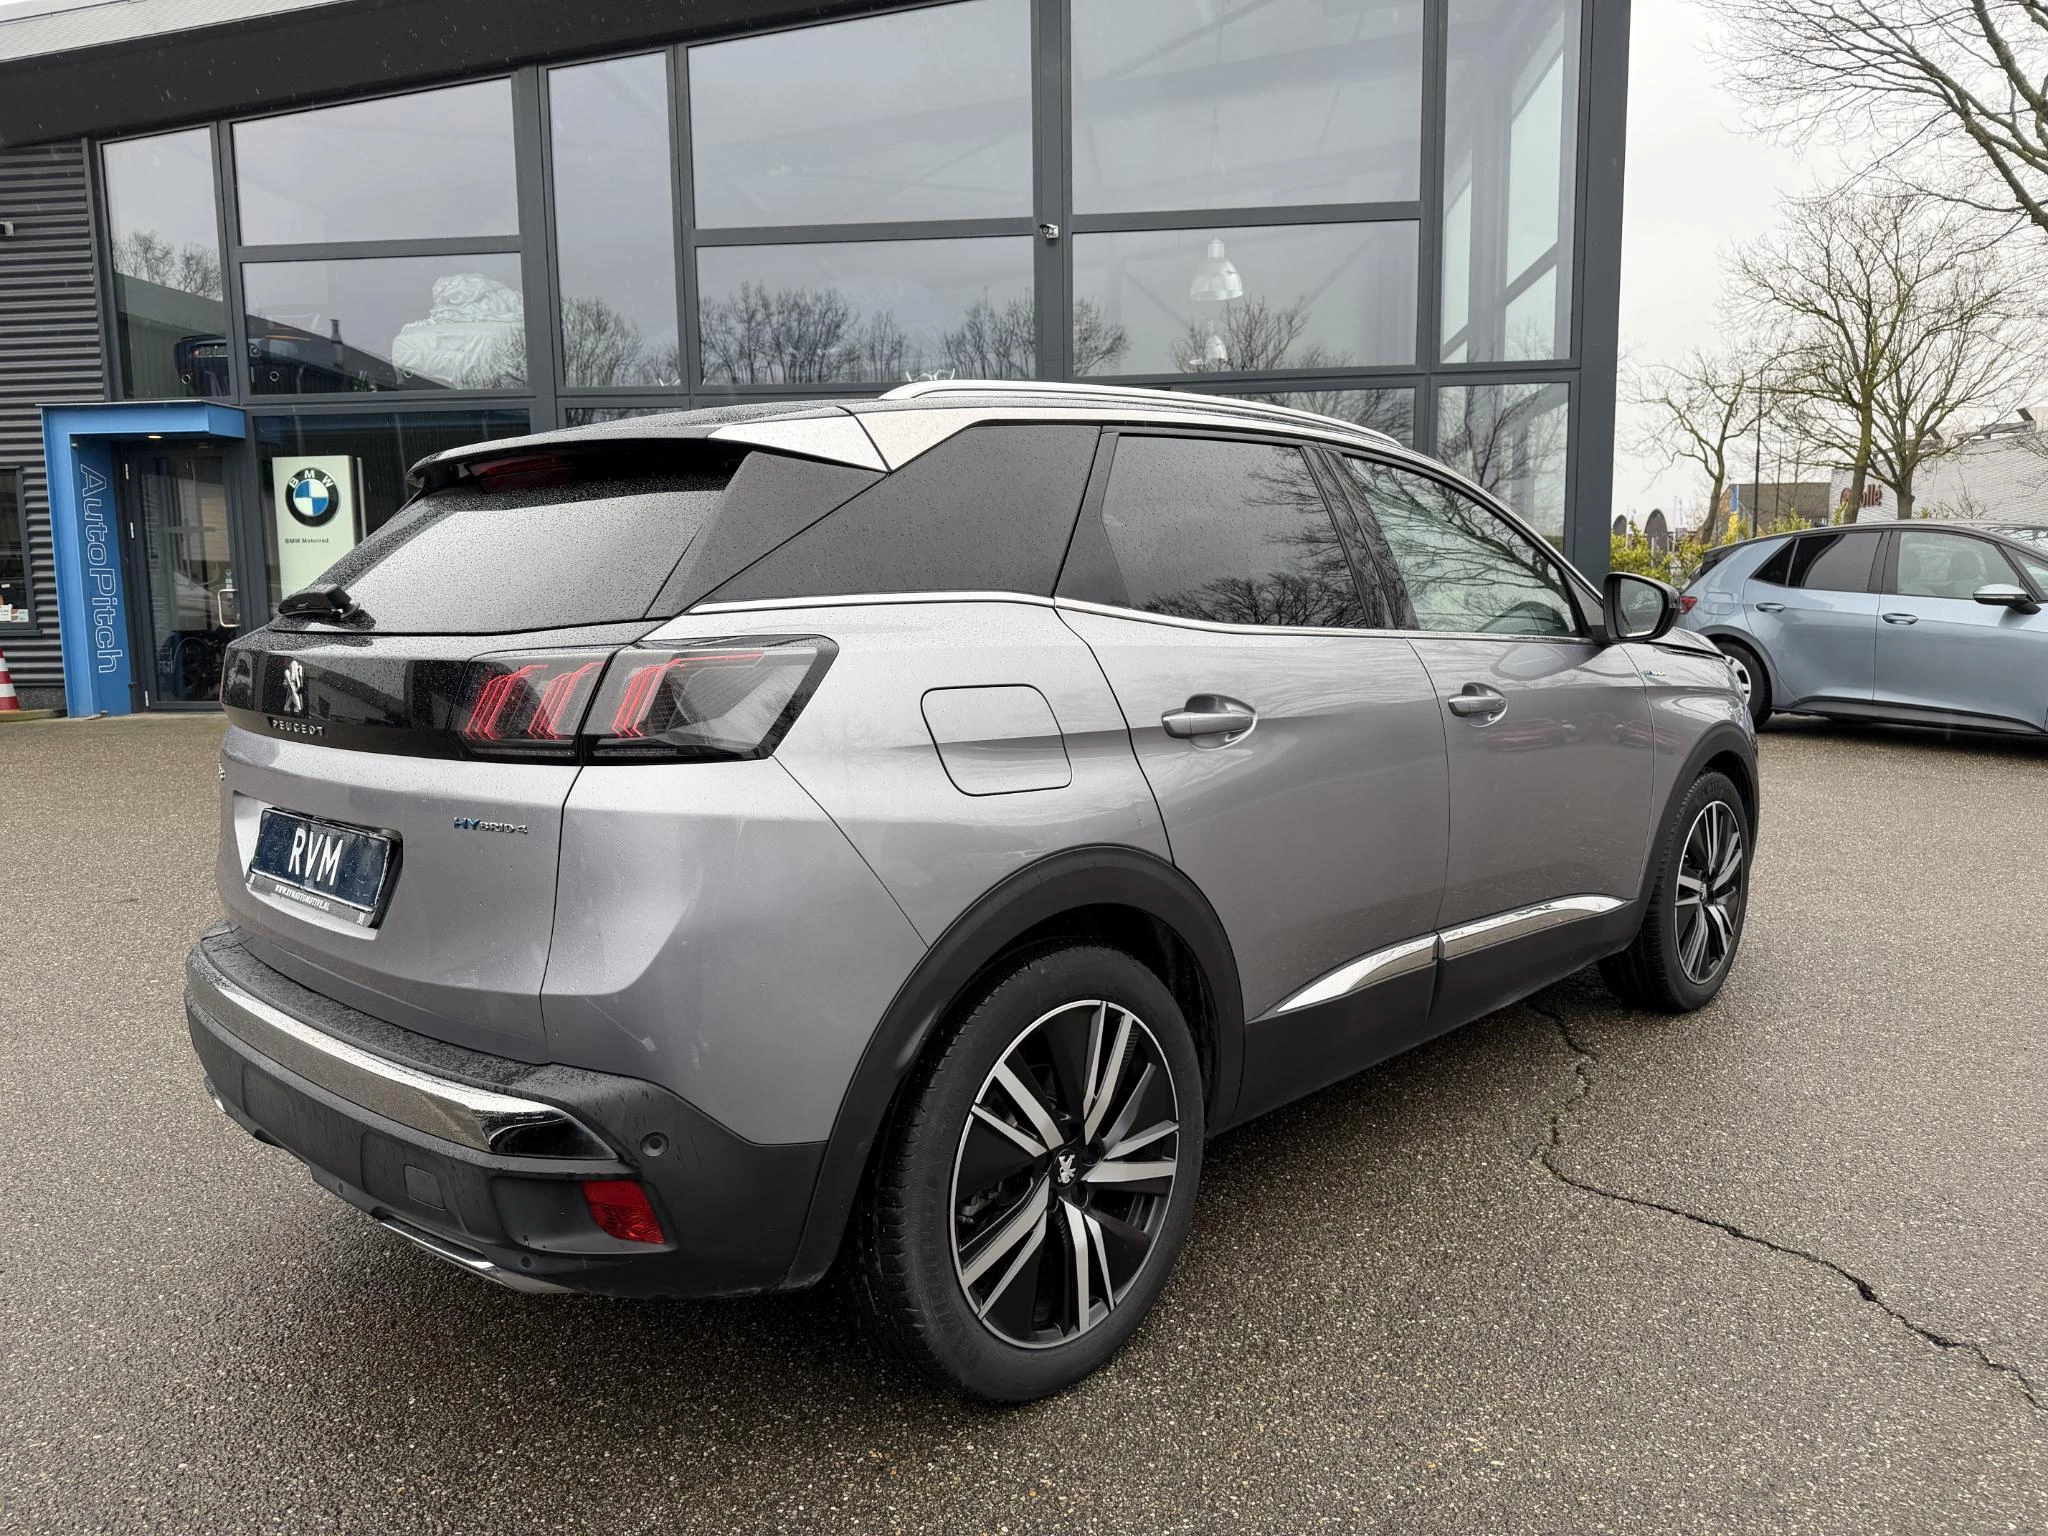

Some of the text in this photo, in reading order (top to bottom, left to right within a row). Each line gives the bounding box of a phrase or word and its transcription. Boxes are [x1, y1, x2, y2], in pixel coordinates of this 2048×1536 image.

[80, 463, 123, 674] AutoPitch
[272, 719, 324, 737] PEUGEOT
[288, 827, 344, 886] RVM
